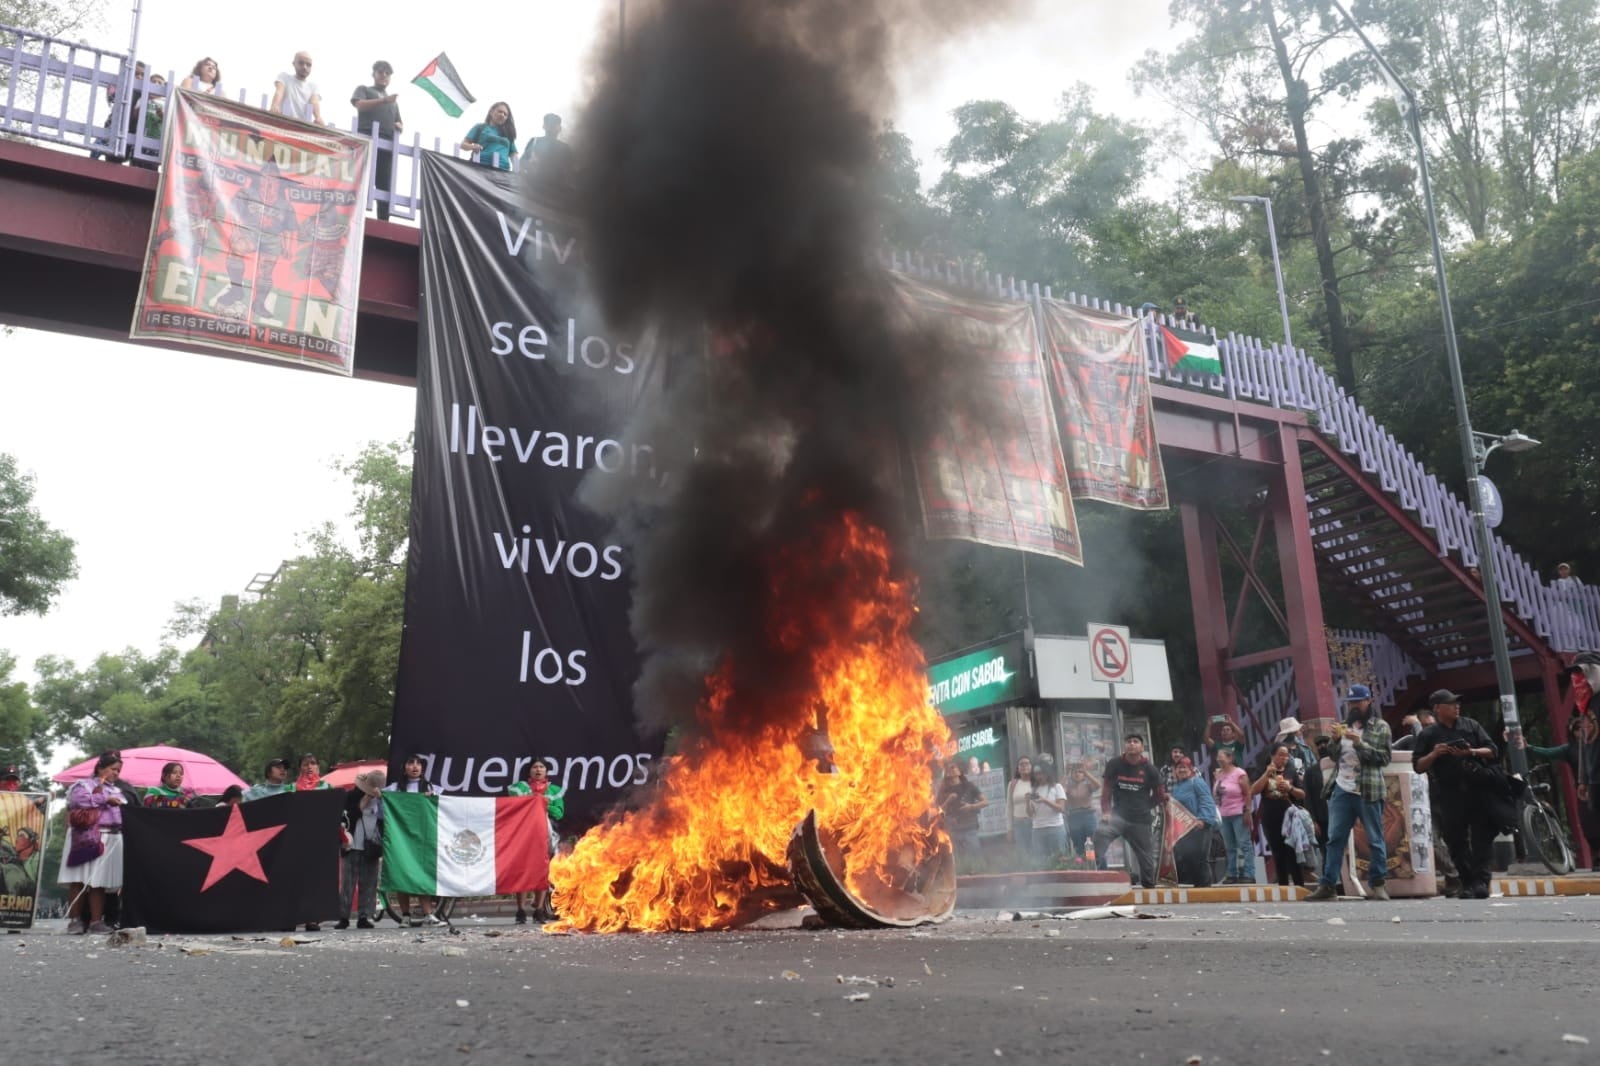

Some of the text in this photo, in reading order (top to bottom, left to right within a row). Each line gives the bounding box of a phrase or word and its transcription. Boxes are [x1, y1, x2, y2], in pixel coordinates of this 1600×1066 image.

[184, 118, 357, 182] MUNDIAL
[290, 188, 357, 202] GUERRA
[495, 209, 577, 265] Viv
[161, 261, 341, 340] EZLN
[257, 327, 265, 339] Y
[490, 317, 635, 375] se los
[493, 524, 623, 580] vivos
[519, 630, 588, 686] los
[951, 670, 971, 698] CON
[972, 656, 1005, 690] SABOR
[958, 736, 971, 752] CON
[971, 727, 993, 748] SABOR
